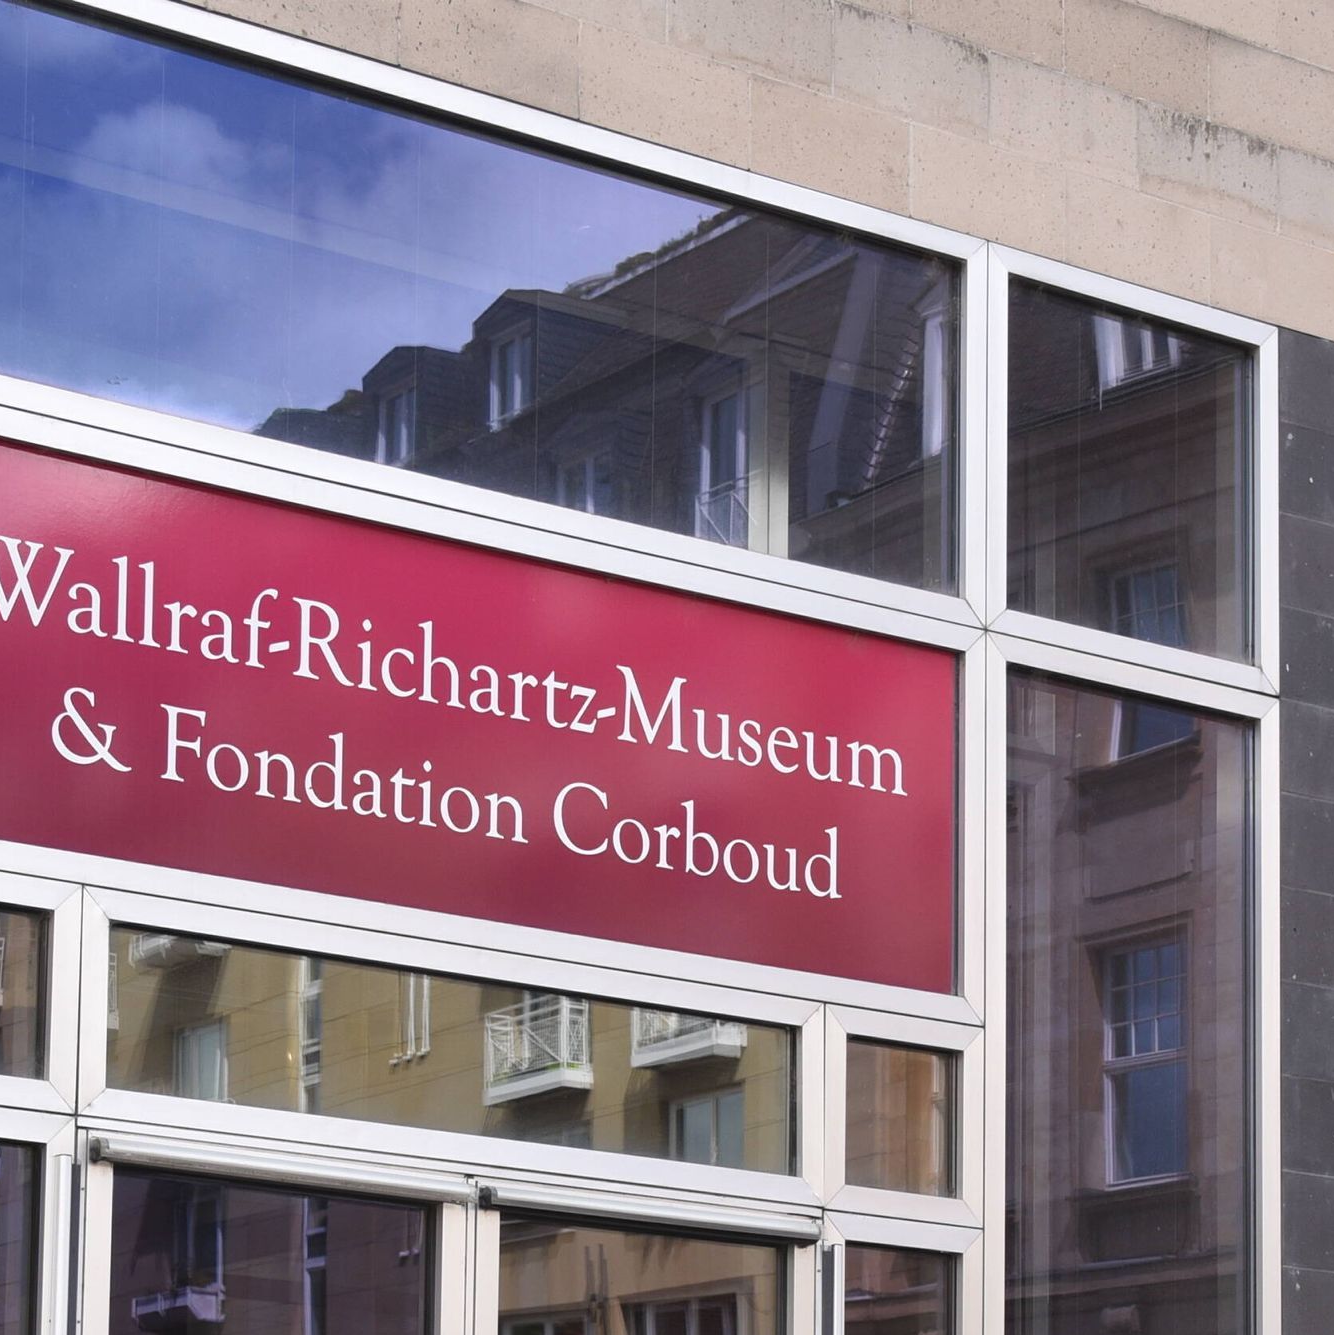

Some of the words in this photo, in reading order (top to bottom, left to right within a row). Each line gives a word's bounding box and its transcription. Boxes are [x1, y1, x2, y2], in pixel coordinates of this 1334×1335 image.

[50, 687, 132, 772] &
[160, 703, 529, 844] Fondation
[553, 782, 843, 899] Corboud
